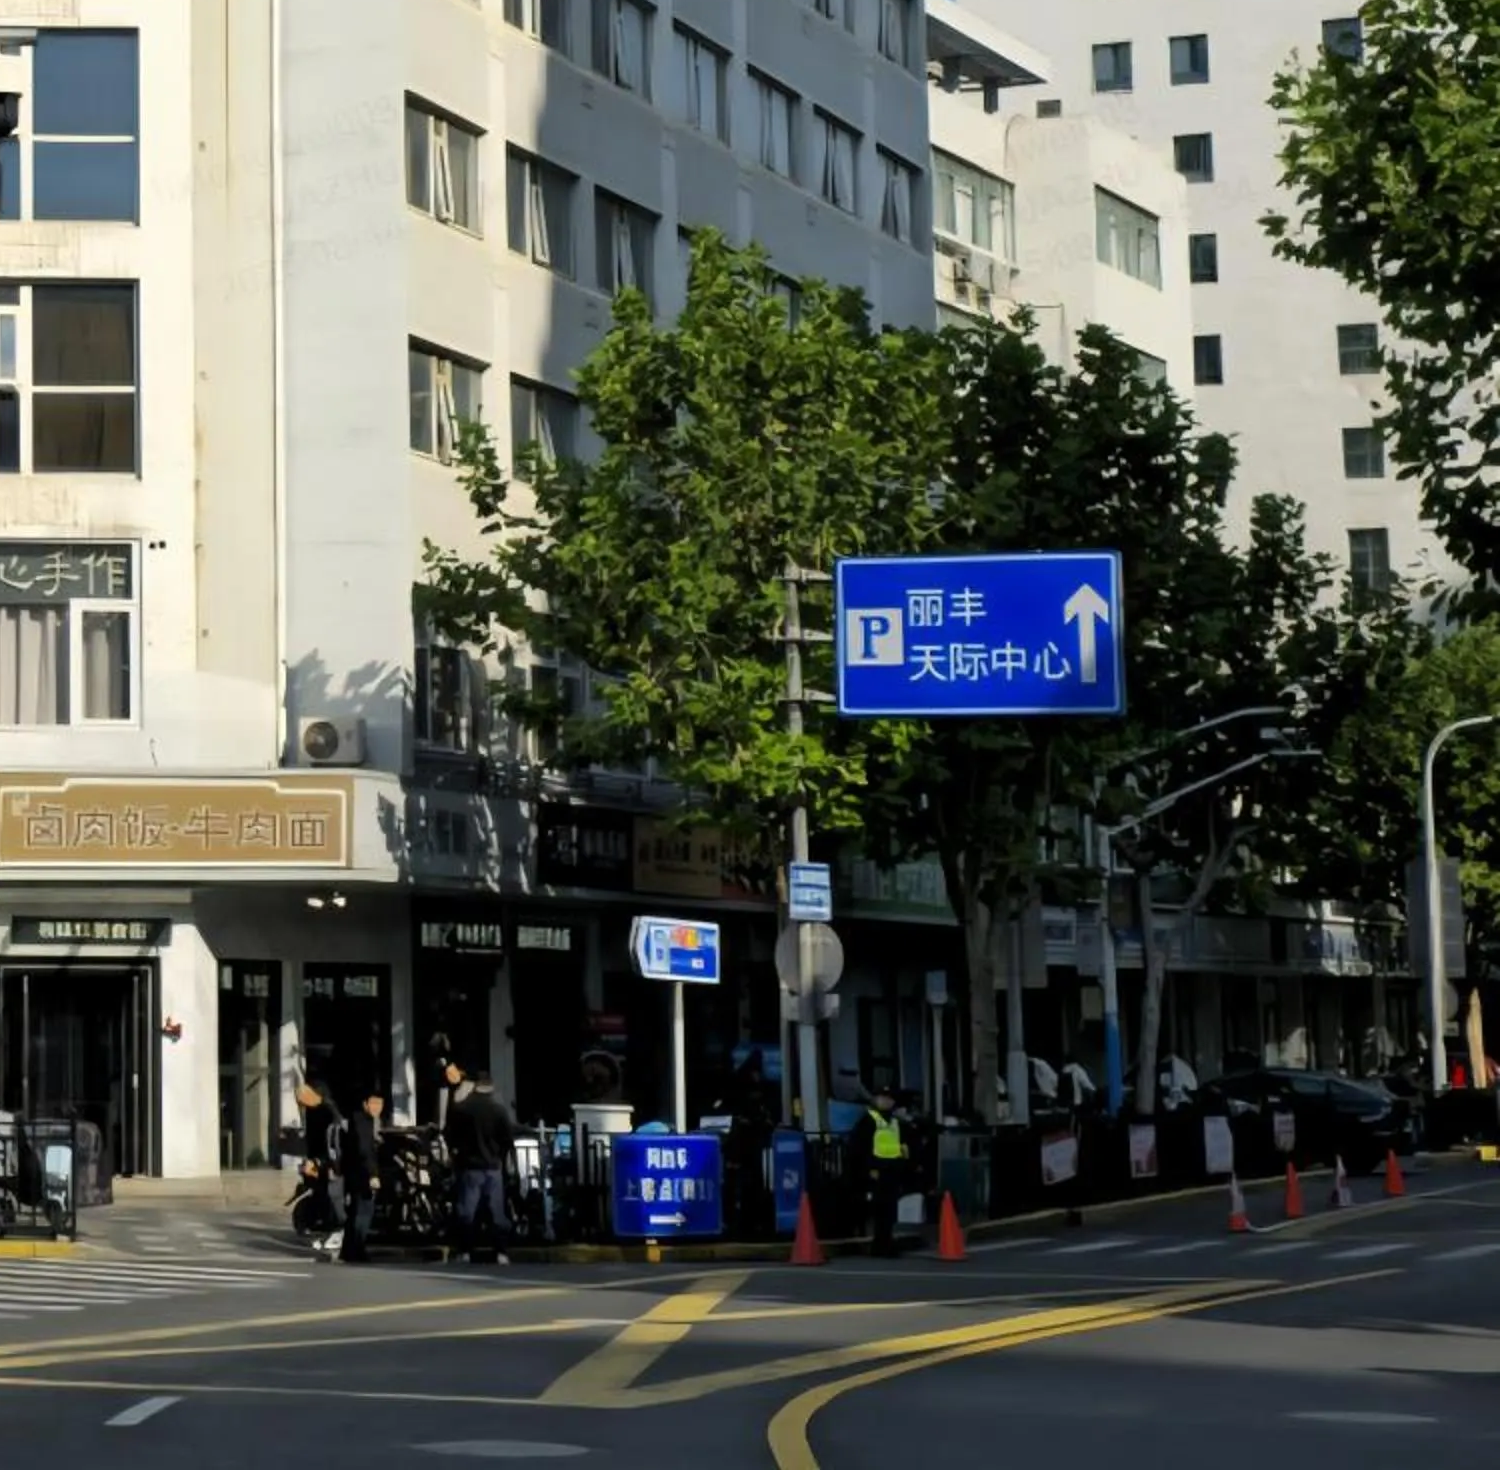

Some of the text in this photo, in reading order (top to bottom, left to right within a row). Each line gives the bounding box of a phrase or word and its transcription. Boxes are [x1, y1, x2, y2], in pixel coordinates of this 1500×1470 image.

[906, 587, 987, 627] 丽丰
[858, 615, 891, 660] P
[908, 641, 1072, 682] 天际中心
